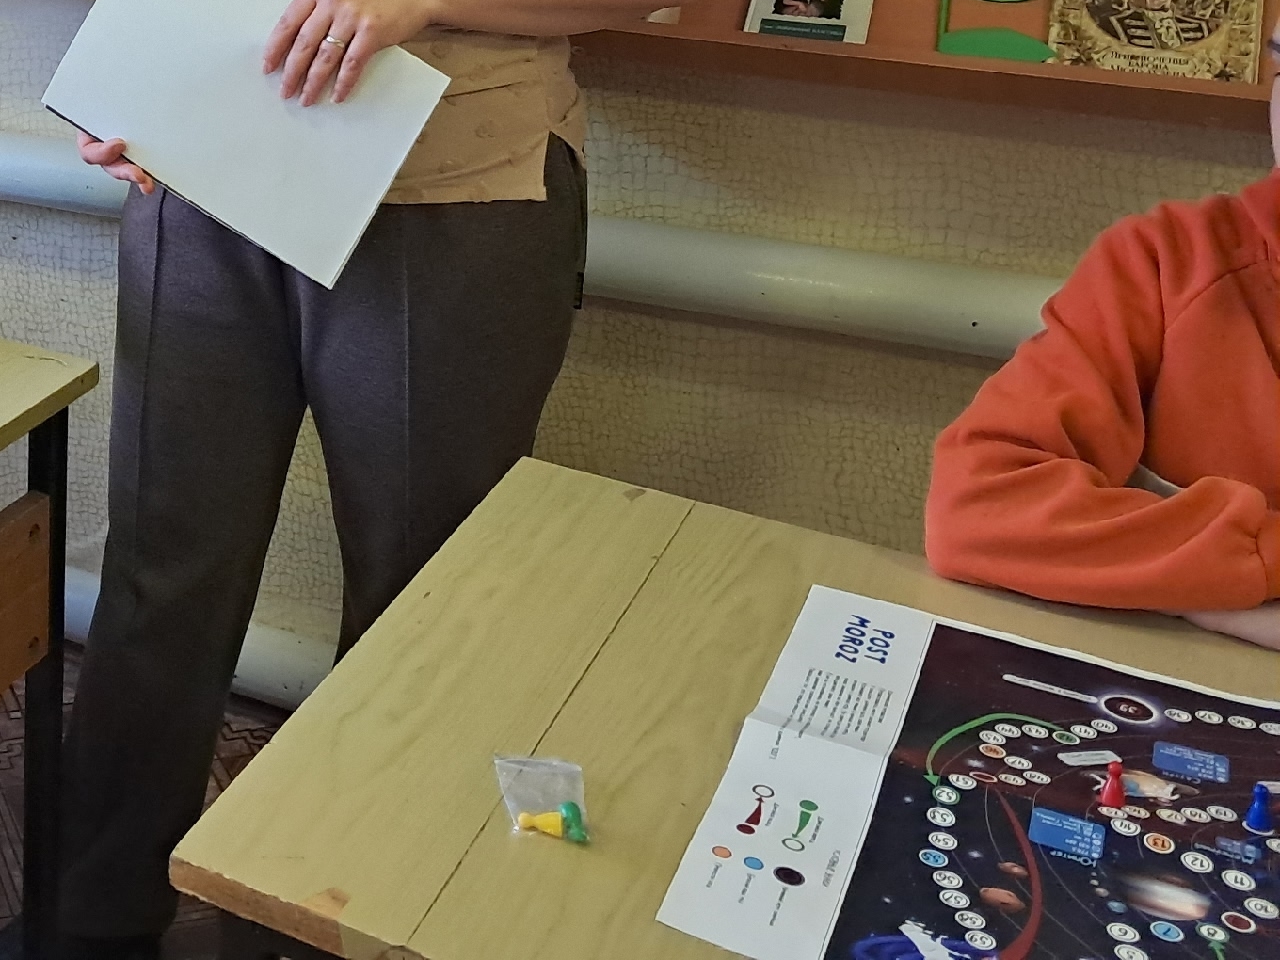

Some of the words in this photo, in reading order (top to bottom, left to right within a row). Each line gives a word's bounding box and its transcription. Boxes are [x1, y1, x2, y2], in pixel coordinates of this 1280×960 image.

[835, 614, 871, 663] MOROZ
[864, 629, 895, 664] POST
[937, 790, 954, 801] 52
[930, 810, 948, 823] 53
[933, 836, 951, 846] 54
[1190, 856, 1206, 868] 12
[937, 872, 955, 885] 56
[1233, 875, 1246, 886] 11
[945, 893, 963, 905] 57
[959, 913, 978, 926] 58
[1118, 928, 1128, 938] 6
